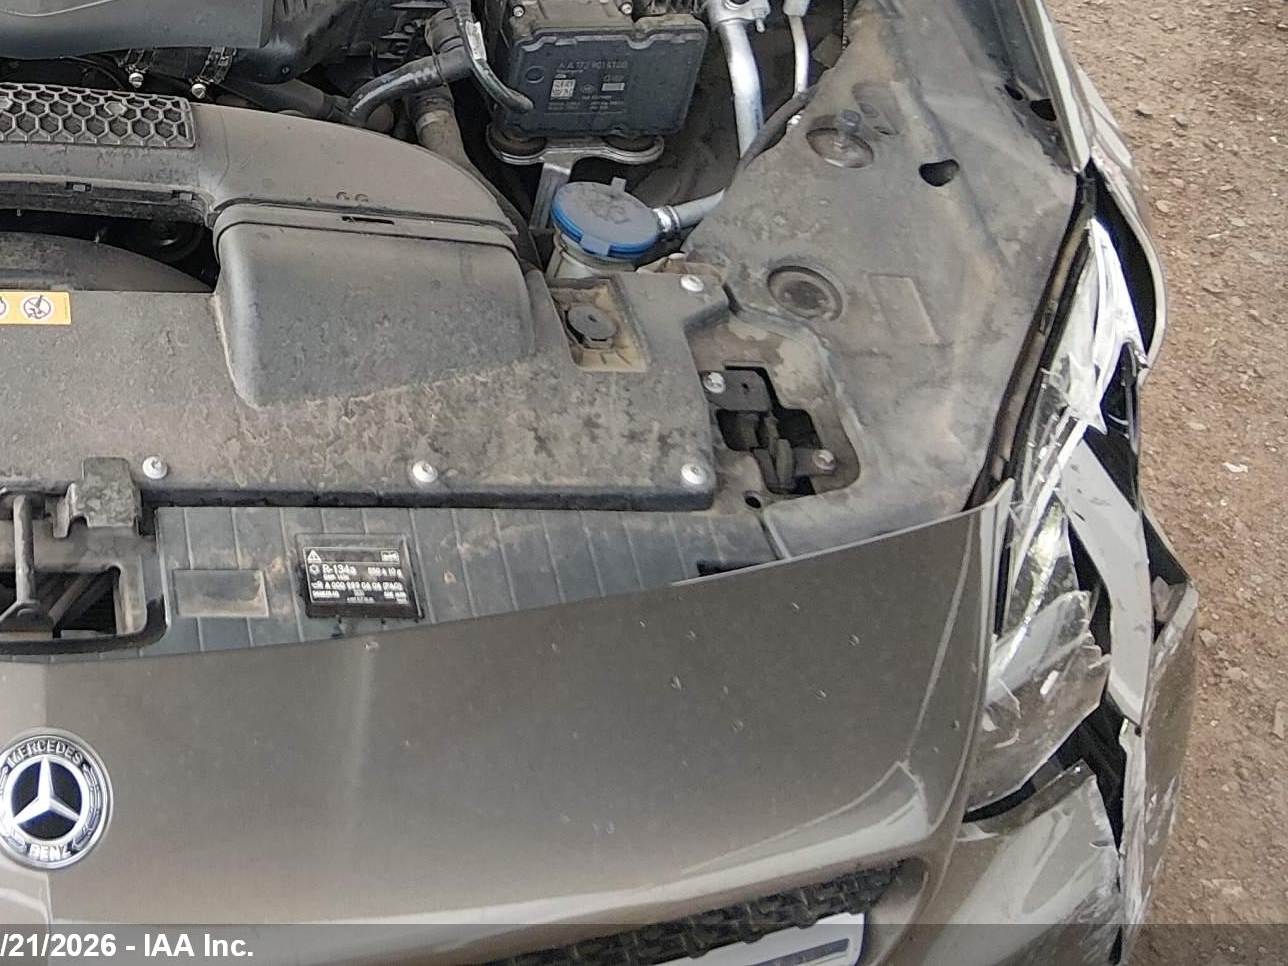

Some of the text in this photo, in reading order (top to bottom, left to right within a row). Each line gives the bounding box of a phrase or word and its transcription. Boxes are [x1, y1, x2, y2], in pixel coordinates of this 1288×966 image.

[322, 564, 357, 576] R-134a
[6, 739, 84, 767] MERCEDES
[28, 843, 72, 862] BENZ
